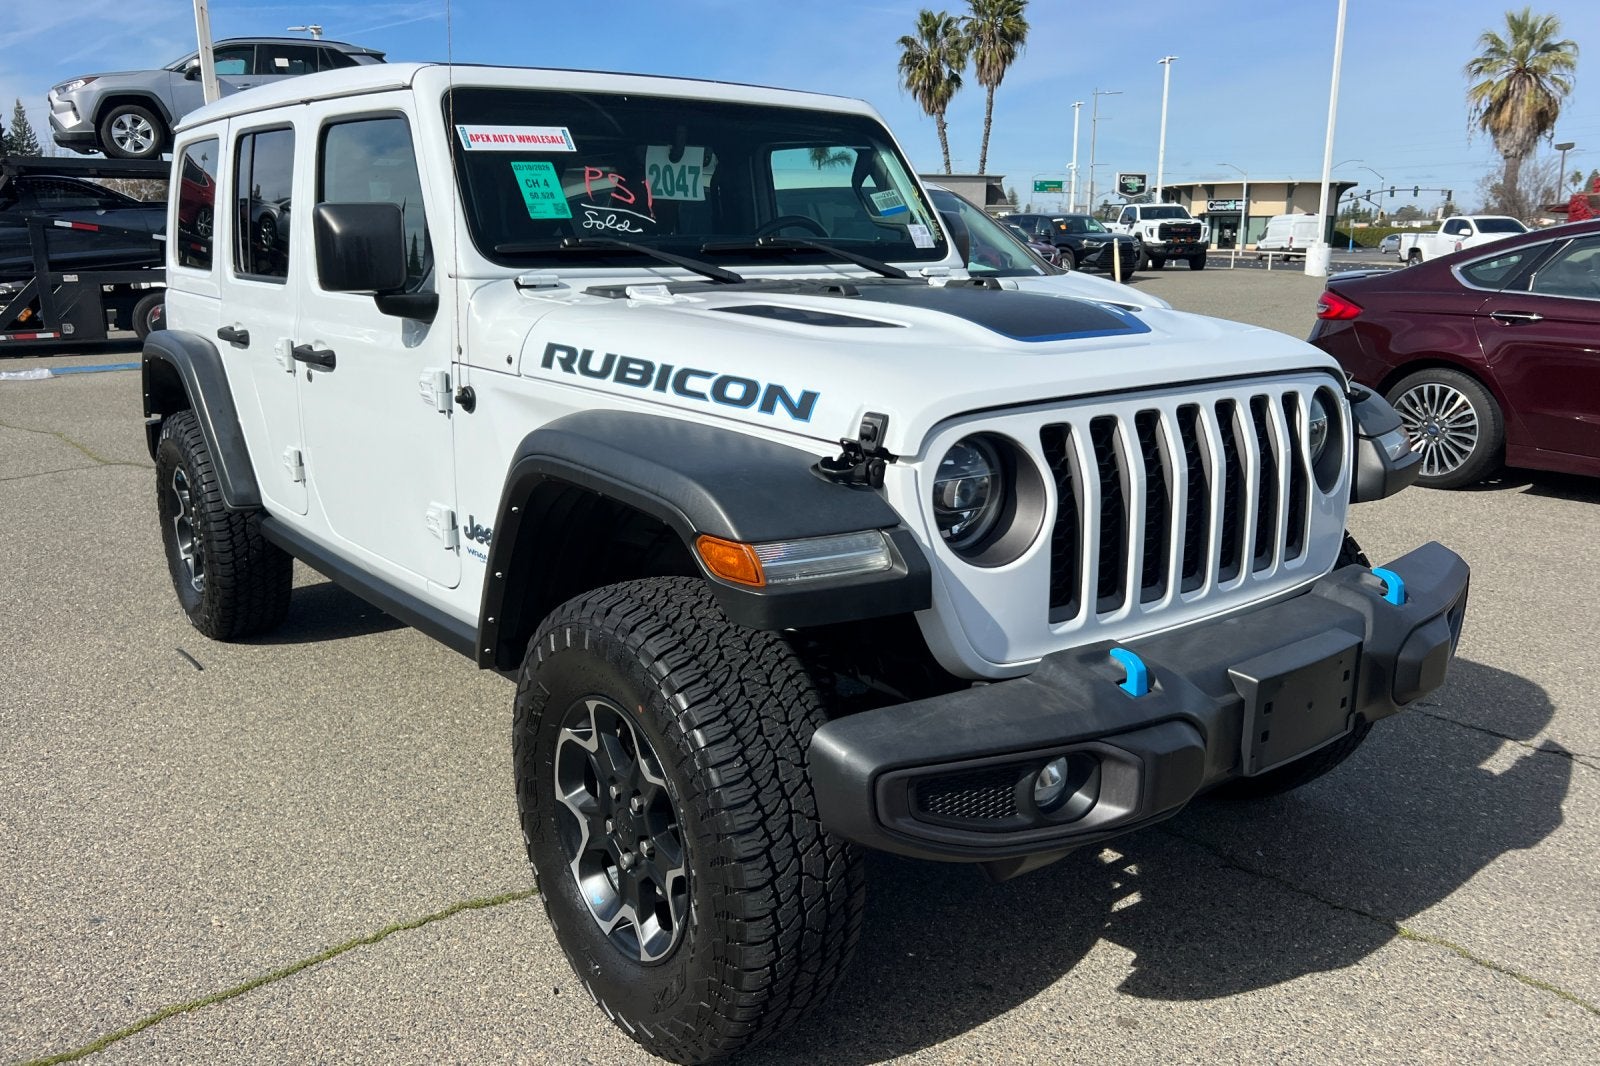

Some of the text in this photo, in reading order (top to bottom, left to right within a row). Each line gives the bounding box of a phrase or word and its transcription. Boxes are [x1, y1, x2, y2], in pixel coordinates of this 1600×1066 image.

[469, 133, 492, 143] APEX
[492, 134, 516, 144] AUTO
[516, 134, 566, 145] WHOLESALE
[525, 178, 550, 189] CH 4
[648, 163, 701, 198] 2047
[541, 342, 821, 423] RUBICON
[463, 514, 493, 547] Jee
